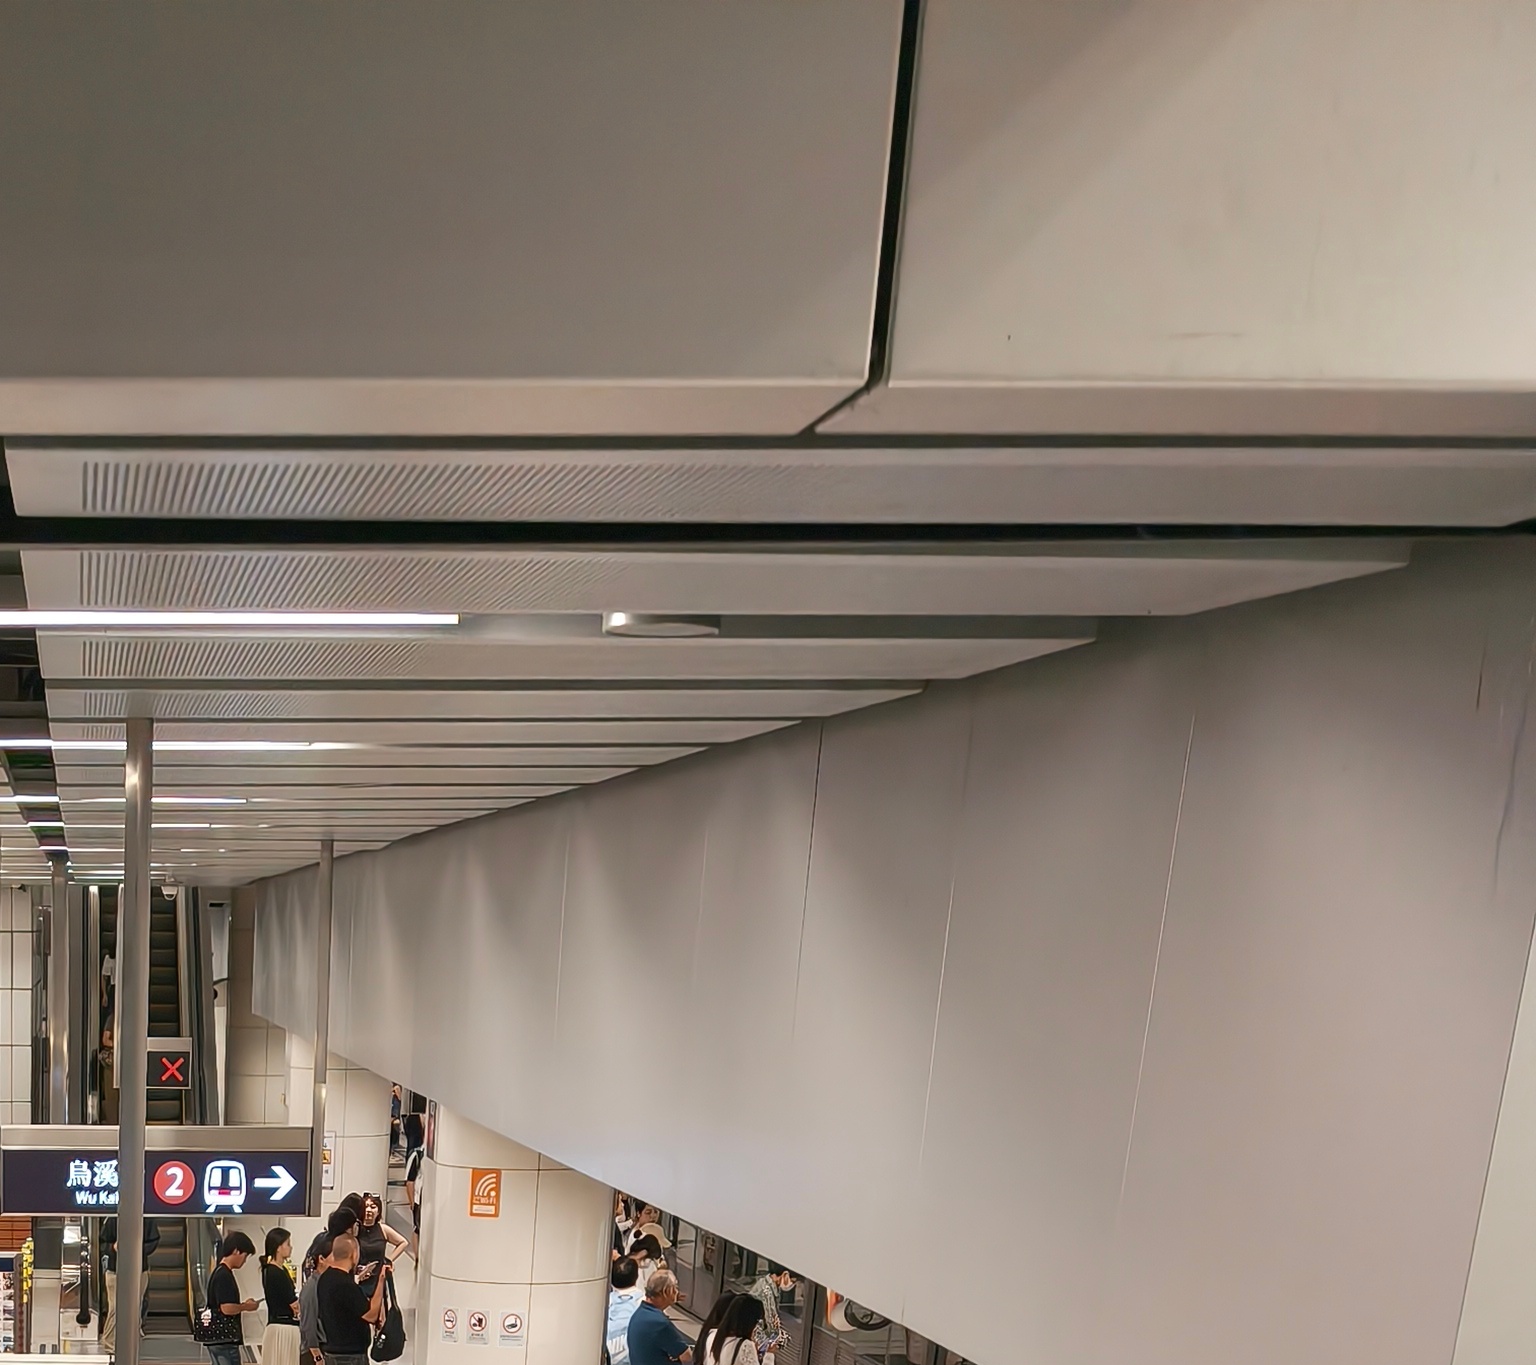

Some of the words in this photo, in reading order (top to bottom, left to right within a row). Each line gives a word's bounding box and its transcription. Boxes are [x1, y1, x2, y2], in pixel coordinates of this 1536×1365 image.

[66, 1159, 120, 1188] 烏溪
[165, 1166, 184, 1197] 2
[75, 1190, 98, 1205] Wu
